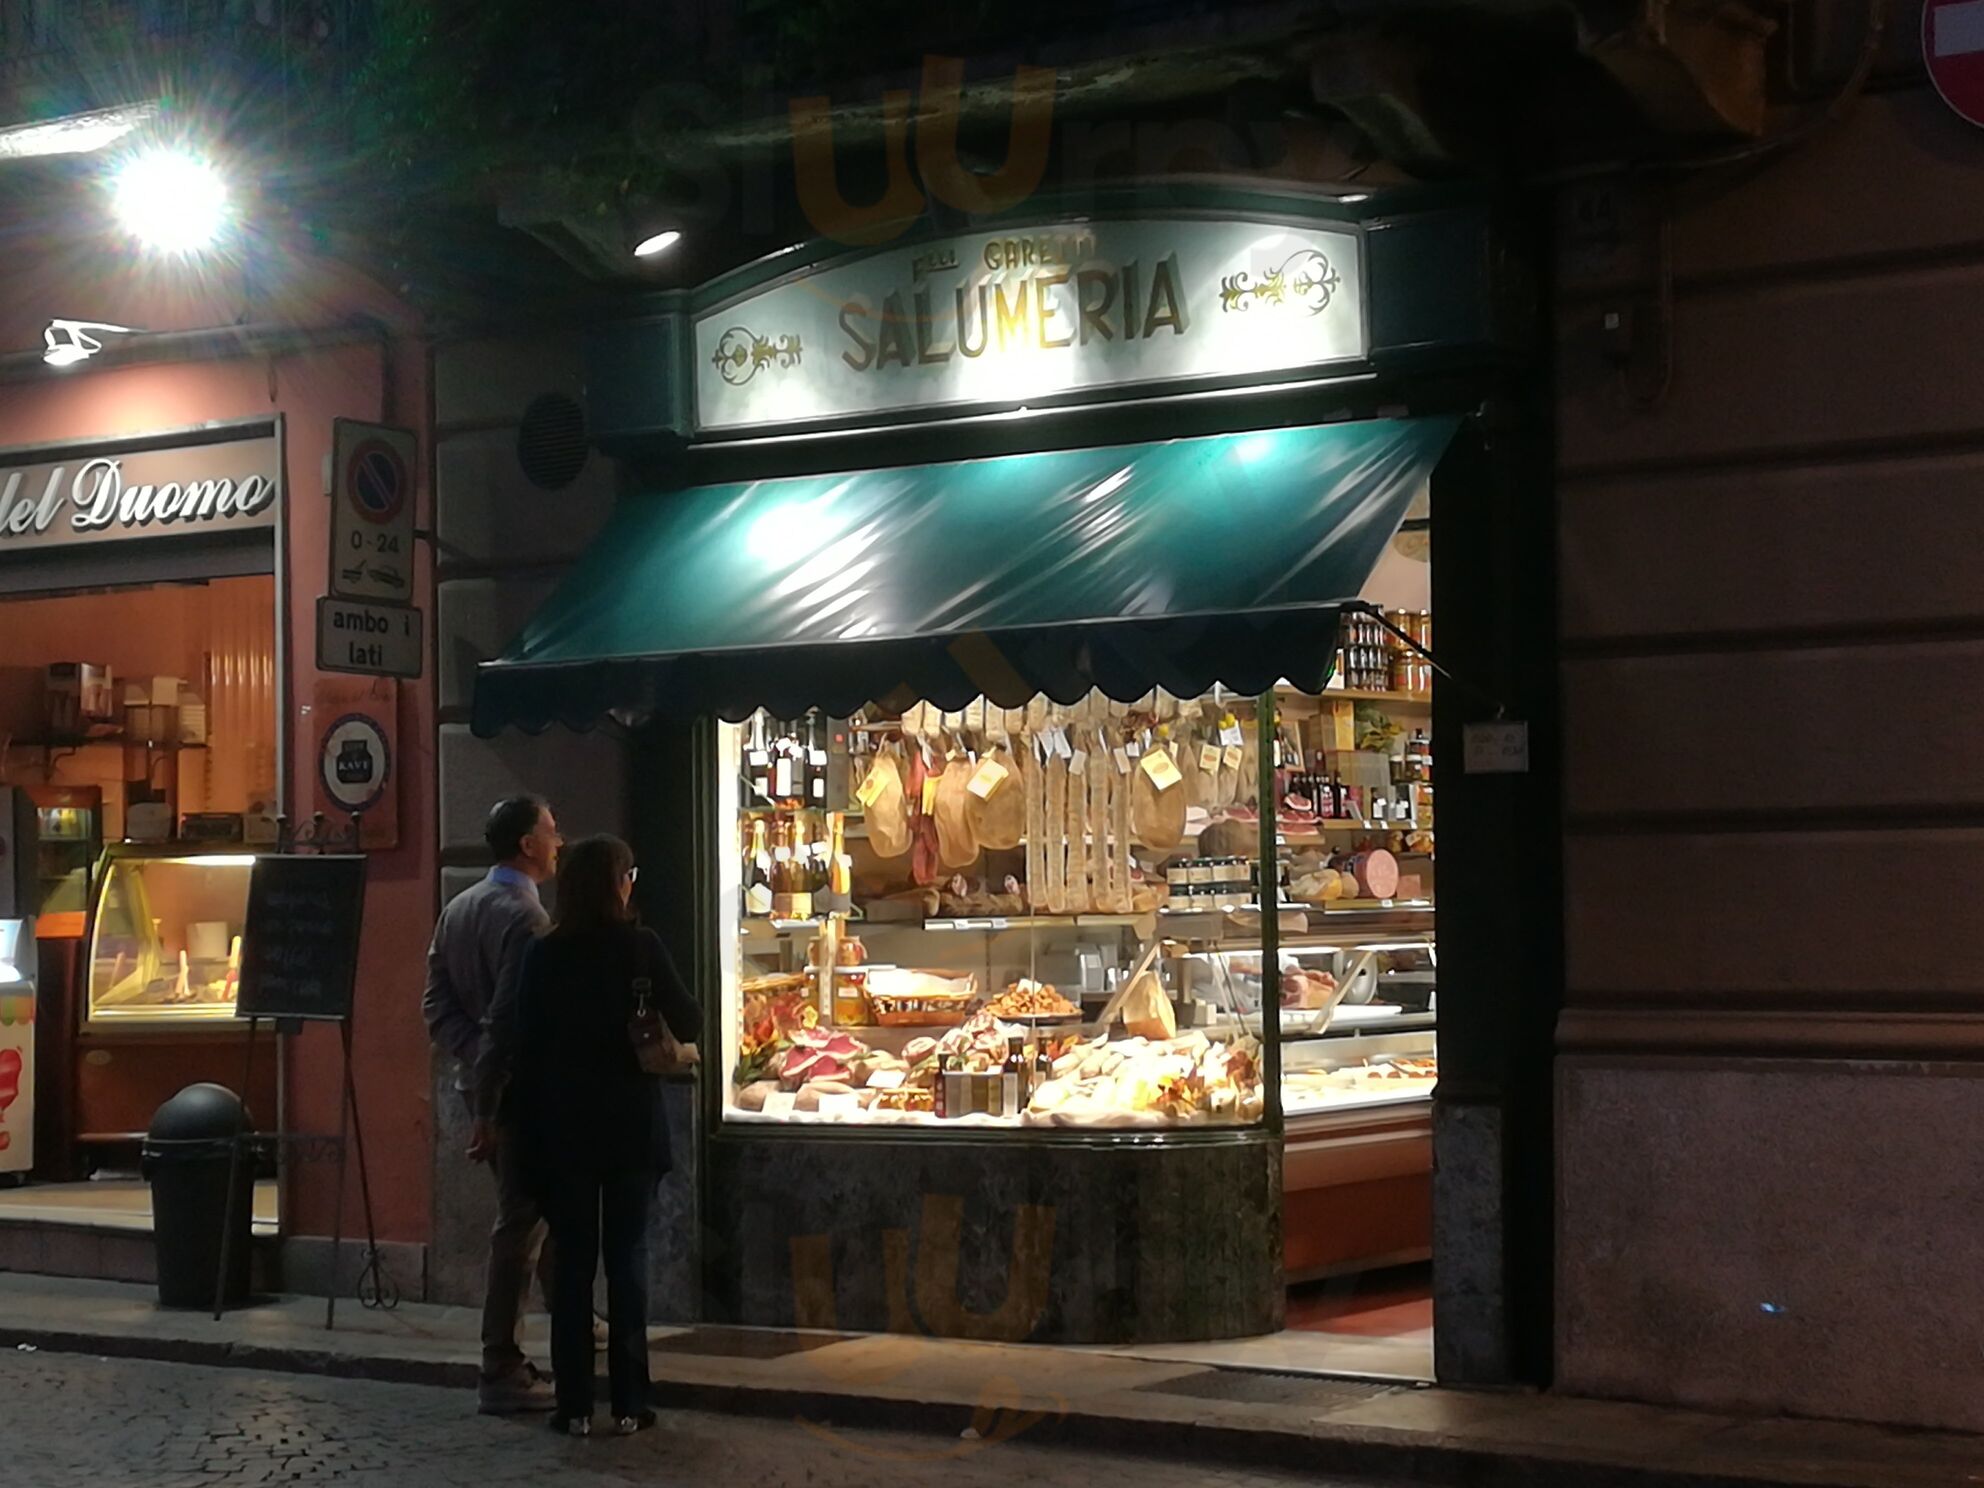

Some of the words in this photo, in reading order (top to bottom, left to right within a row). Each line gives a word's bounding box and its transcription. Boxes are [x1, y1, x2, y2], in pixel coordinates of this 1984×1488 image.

[838, 253, 1189, 372] SALUMERIA
[71, 458, 275, 528] Duomo
[333, 609, 388, 633] ambo
[350, 642, 383, 666] lati
